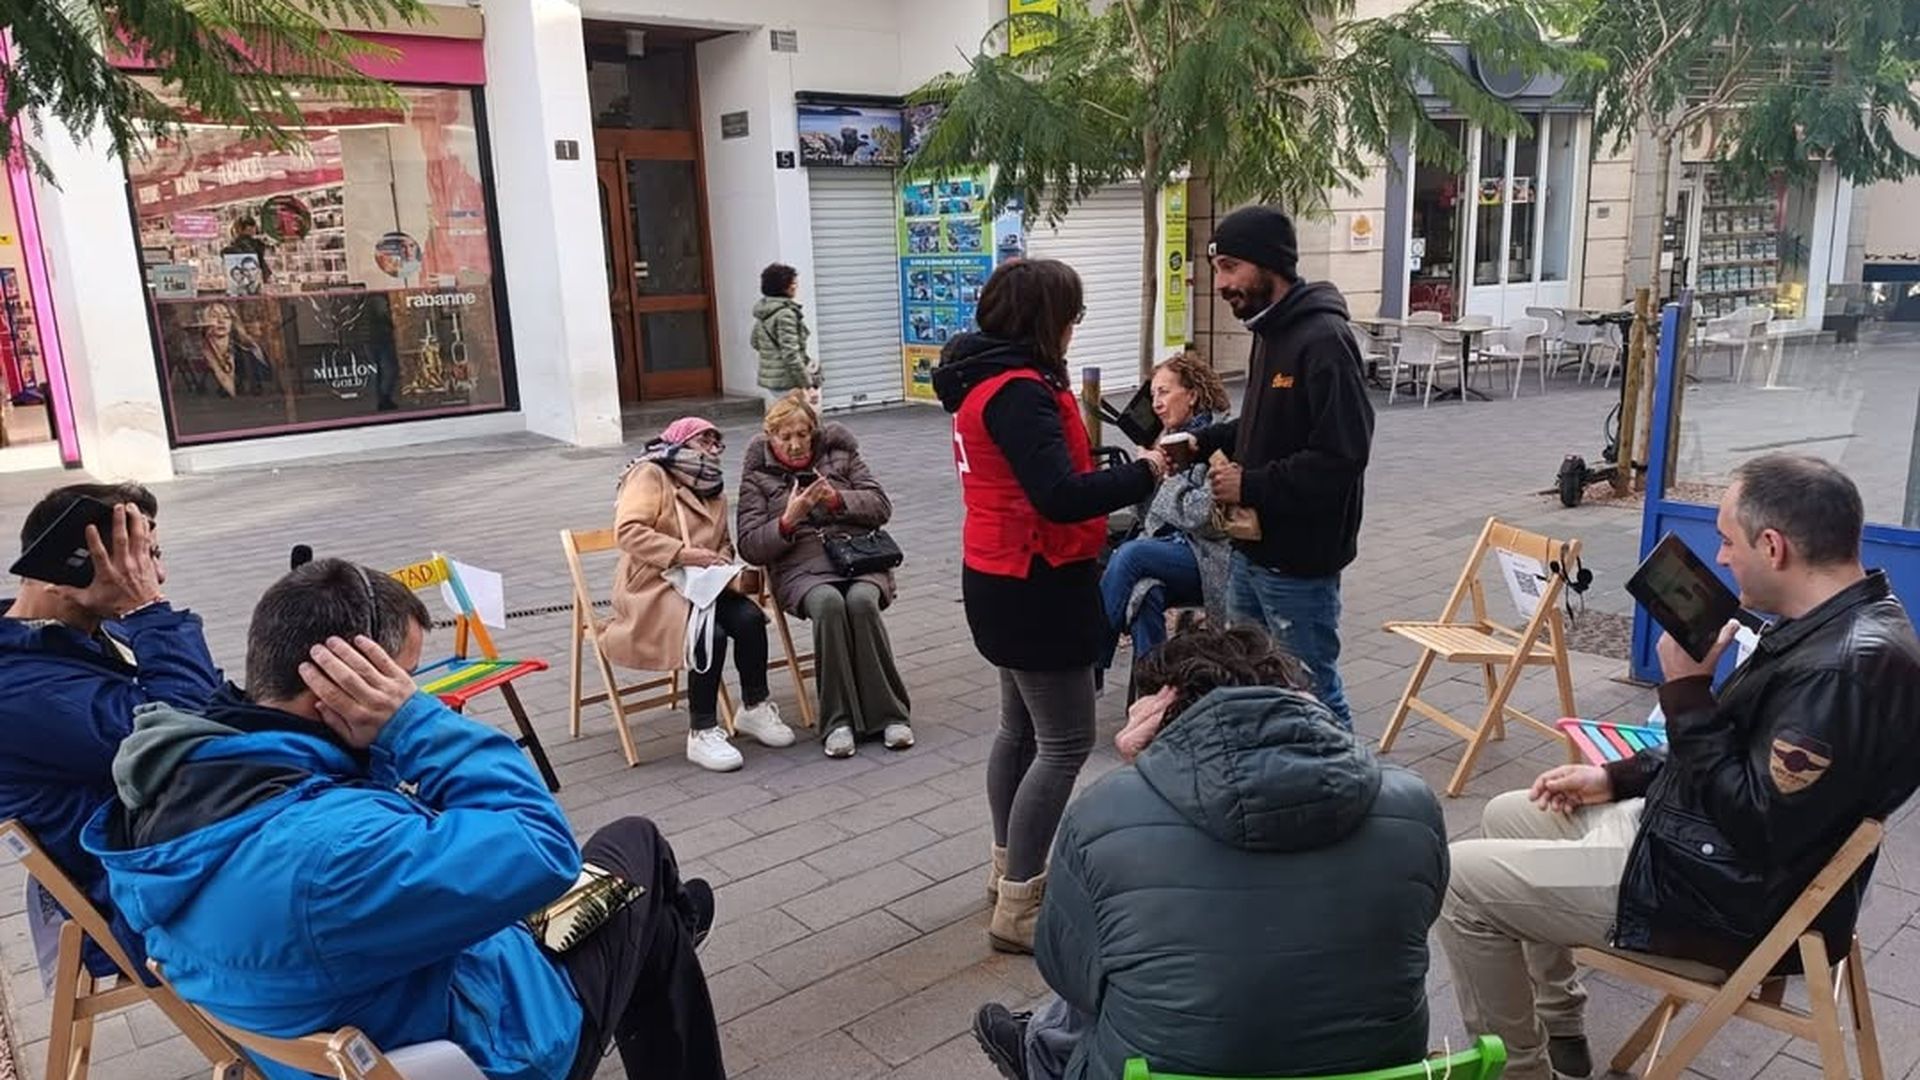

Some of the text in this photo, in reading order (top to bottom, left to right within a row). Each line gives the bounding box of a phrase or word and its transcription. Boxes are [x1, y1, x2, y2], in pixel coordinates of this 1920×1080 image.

[781, 151, 791, 167] 5
[405, 291, 476, 307] rabanne
[313, 363, 378, 379] MILLION
[332, 378, 363, 388] GOLD
